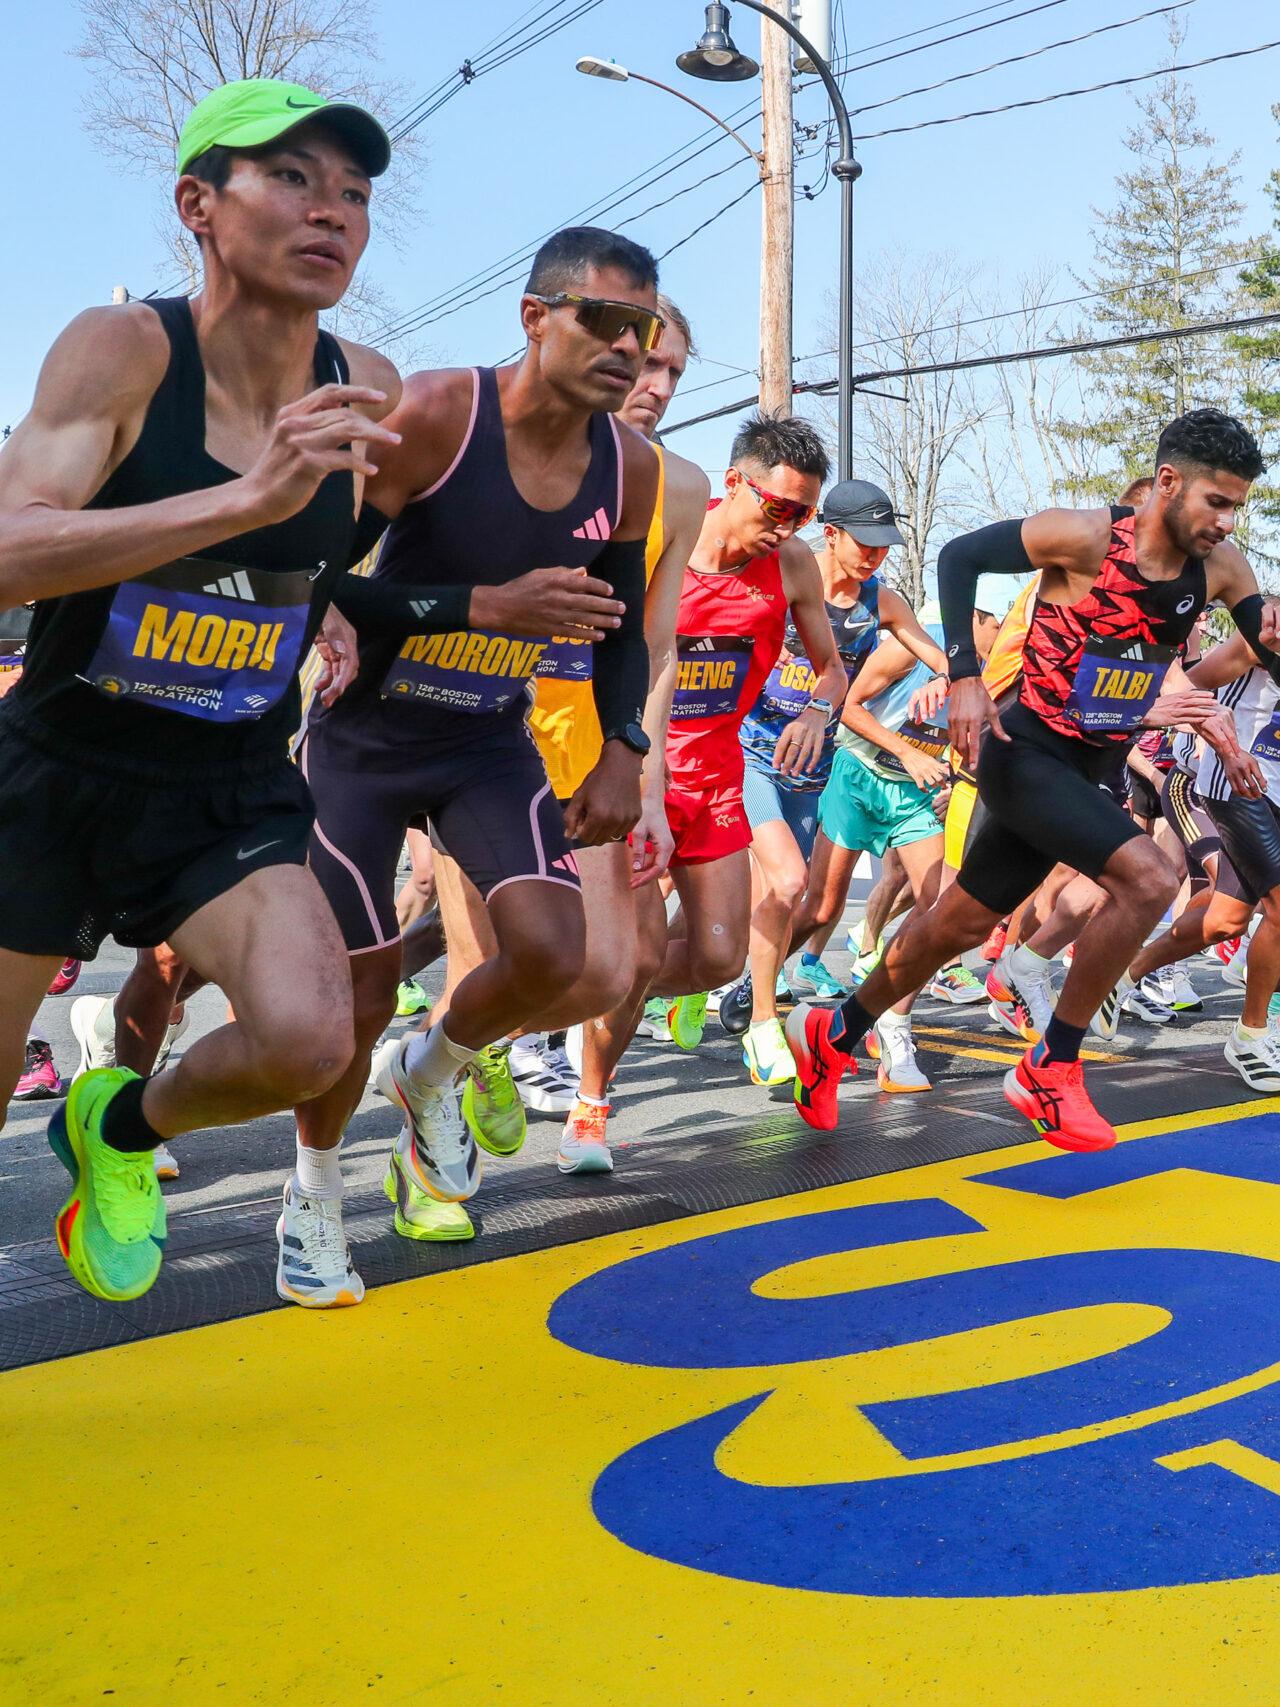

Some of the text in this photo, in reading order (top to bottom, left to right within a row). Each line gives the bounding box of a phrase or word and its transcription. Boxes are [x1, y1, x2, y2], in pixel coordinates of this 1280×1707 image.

[132, 603, 284, 671] MORII
[399, 631, 548, 678] MORONE
[675, 660, 737, 690] HENG
[780, 663, 817, 692] OSA
[1092, 667, 1153, 700] TALBI
[133, 688, 220, 711] ARATHON
[415, 691, 479, 708] MARATHON
[441, 688, 482, 701] BOSTON
[678, 703, 707, 711] BOSTON
[669, 708, 706, 717] ARATHON
